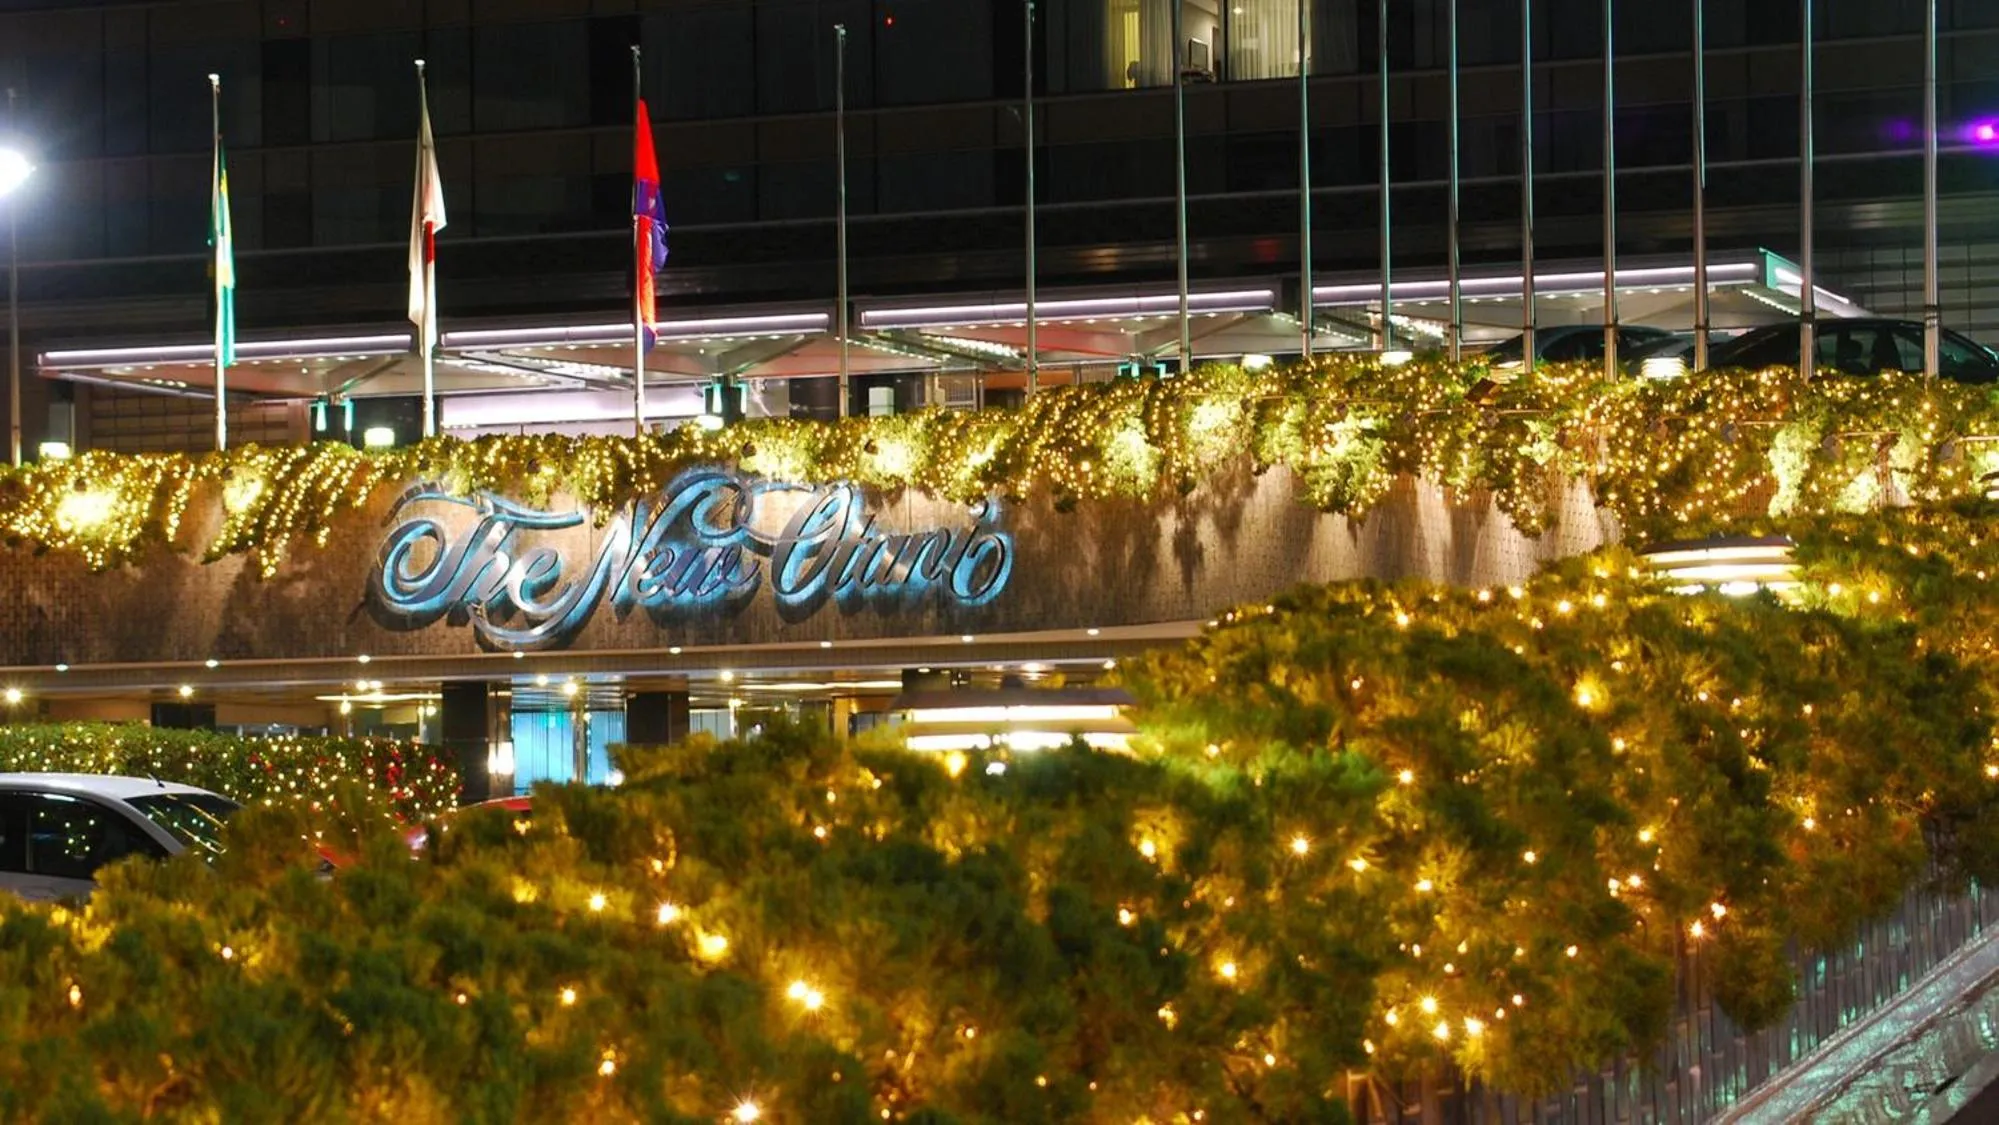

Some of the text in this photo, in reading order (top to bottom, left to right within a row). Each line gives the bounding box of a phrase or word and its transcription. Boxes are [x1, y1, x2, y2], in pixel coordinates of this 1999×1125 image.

[382, 471, 1010, 642] The New Otani
